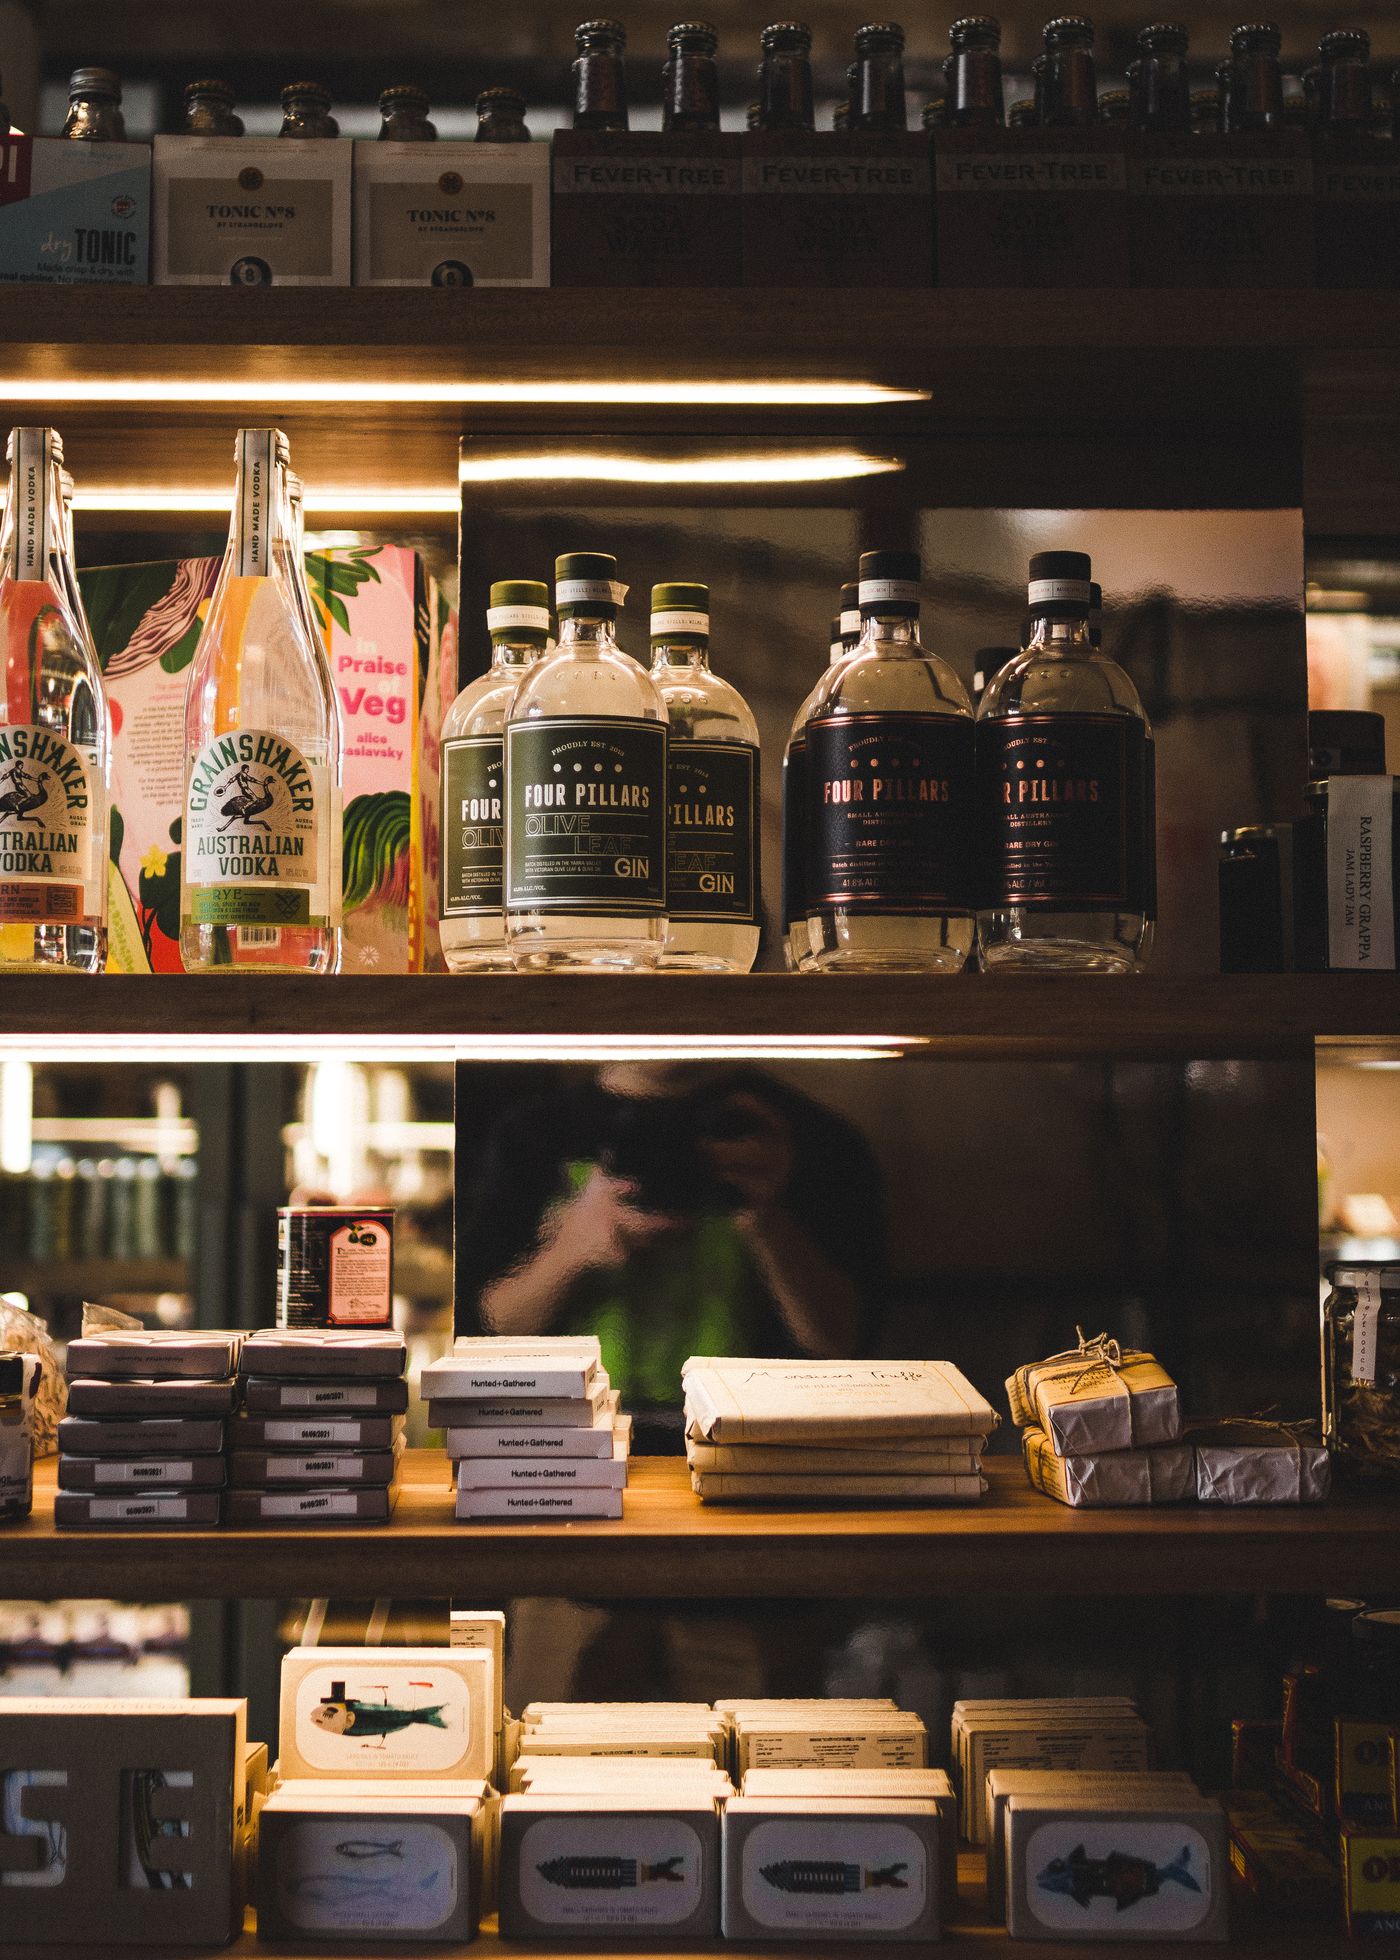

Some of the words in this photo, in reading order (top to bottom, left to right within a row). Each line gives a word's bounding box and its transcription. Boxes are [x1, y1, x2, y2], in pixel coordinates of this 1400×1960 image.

[575, 164, 724, 184] FEVER-TREE
[763, 164, 912, 184] FEVER-TREE
[956, 161, 1107, 180] FEVER-TREE
[1144, 166, 1295, 186] FEVER-TREE
[206, 205, 262, 219] TONIC
[406, 210, 462, 223] TONIC
[75, 229, 137, 265] TONIC
[246, 269, 255, 282] 8
[27, 465, 36, 502] VODKA
[253, 461, 262, 498] VODKA
[27, 506, 35, 535] MADE
[252, 502, 261, 531] MADE
[26, 539, 35, 567] HAND
[251, 534, 260, 563] HAND
[338, 655, 408, 676] Praise
[339, 687, 406, 724] Veg
[356, 732, 388, 745] alice
[551, 740, 588, 757] PROUDLY
[190, 734, 315, 813] GRAINSHAKER
[525, 783, 566, 808] FOUR
[575, 783, 650, 809] PILLARS
[823, 779, 864, 807] FOUR
[872, 778, 951, 803] PILLARS
[1018, 779, 1100, 803] PILLARS
[461, 798, 502, 822] FOUR
[525, 815, 591, 836] OLIVE
[197, 835, 304, 856] AUSTRALIAN
[574, 835, 634, 855] LEAF
[855, 839, 878, 848] RARE
[218, 857, 279, 876] VODKA
[1345, 848, 1355, 866] JAM
[1360, 816, 1372, 897] RASPBERRY
[614, 857, 649, 878] GIN
[213, 888, 242, 900] RYE
[699, 873, 735, 894] GIN
[1345, 868, 1355, 904] LADY
[1345, 905, 1355, 926] JAM
[1359, 898, 1373, 962] GRAPPA
[470, 1379, 537, 1388] Hunted+Gathered
[478, 1408, 544, 1417] Hunted+Gathered
[498, 1438, 565, 1447] Hunted+Gathered
[511, 1469, 578, 1478] Hunted+Gathered
[507, 1498, 574, 1507] Hunted+Gathered
